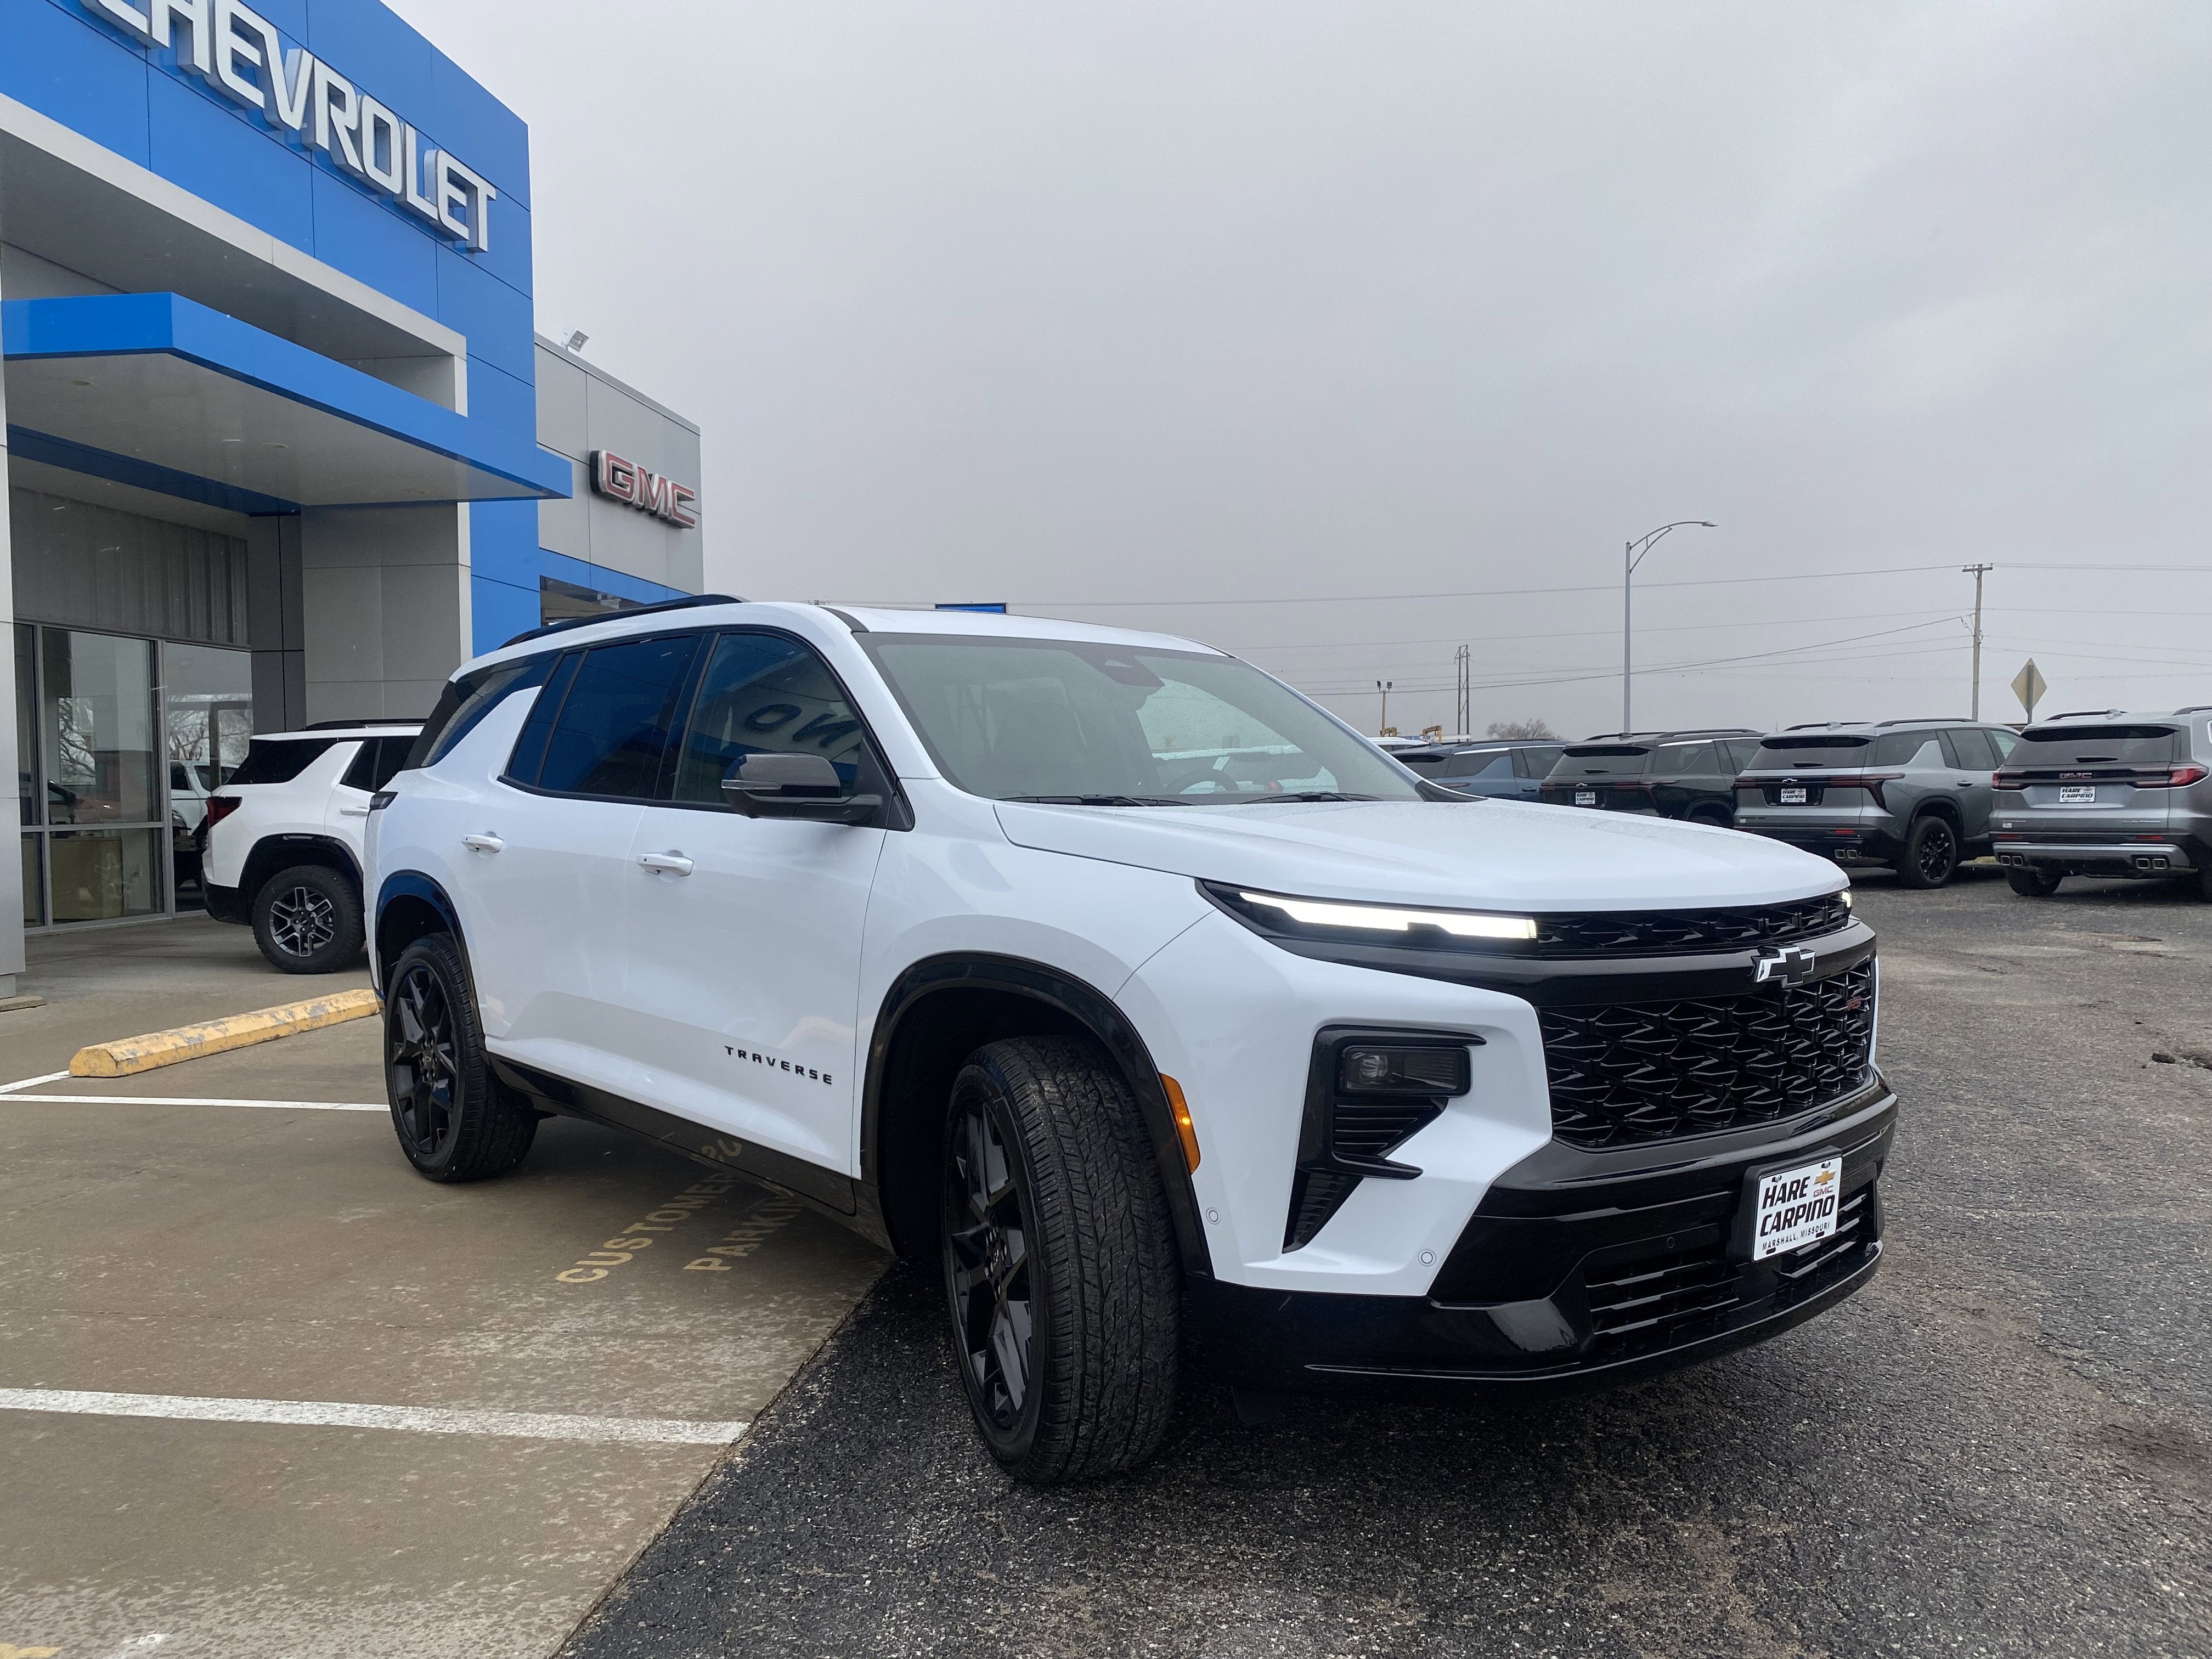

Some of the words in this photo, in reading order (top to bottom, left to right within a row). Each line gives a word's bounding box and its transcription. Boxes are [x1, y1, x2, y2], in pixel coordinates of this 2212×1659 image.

[94, 0, 496, 252] HEVROLET
[594, 449, 695, 529] GMC
[724, 1045, 833, 1085] TRAVERSE
[1762, 1176, 1810, 1209] HARE
[1813, 1185, 1833, 1197] GMC
[682, 1194, 808, 1271] PARKIN
[1760, 1194, 1835, 1237] CARPINO
[1762, 1233, 1799, 1250] MARSHALL,
[1800, 1221, 1830, 1238] MISSOURI
